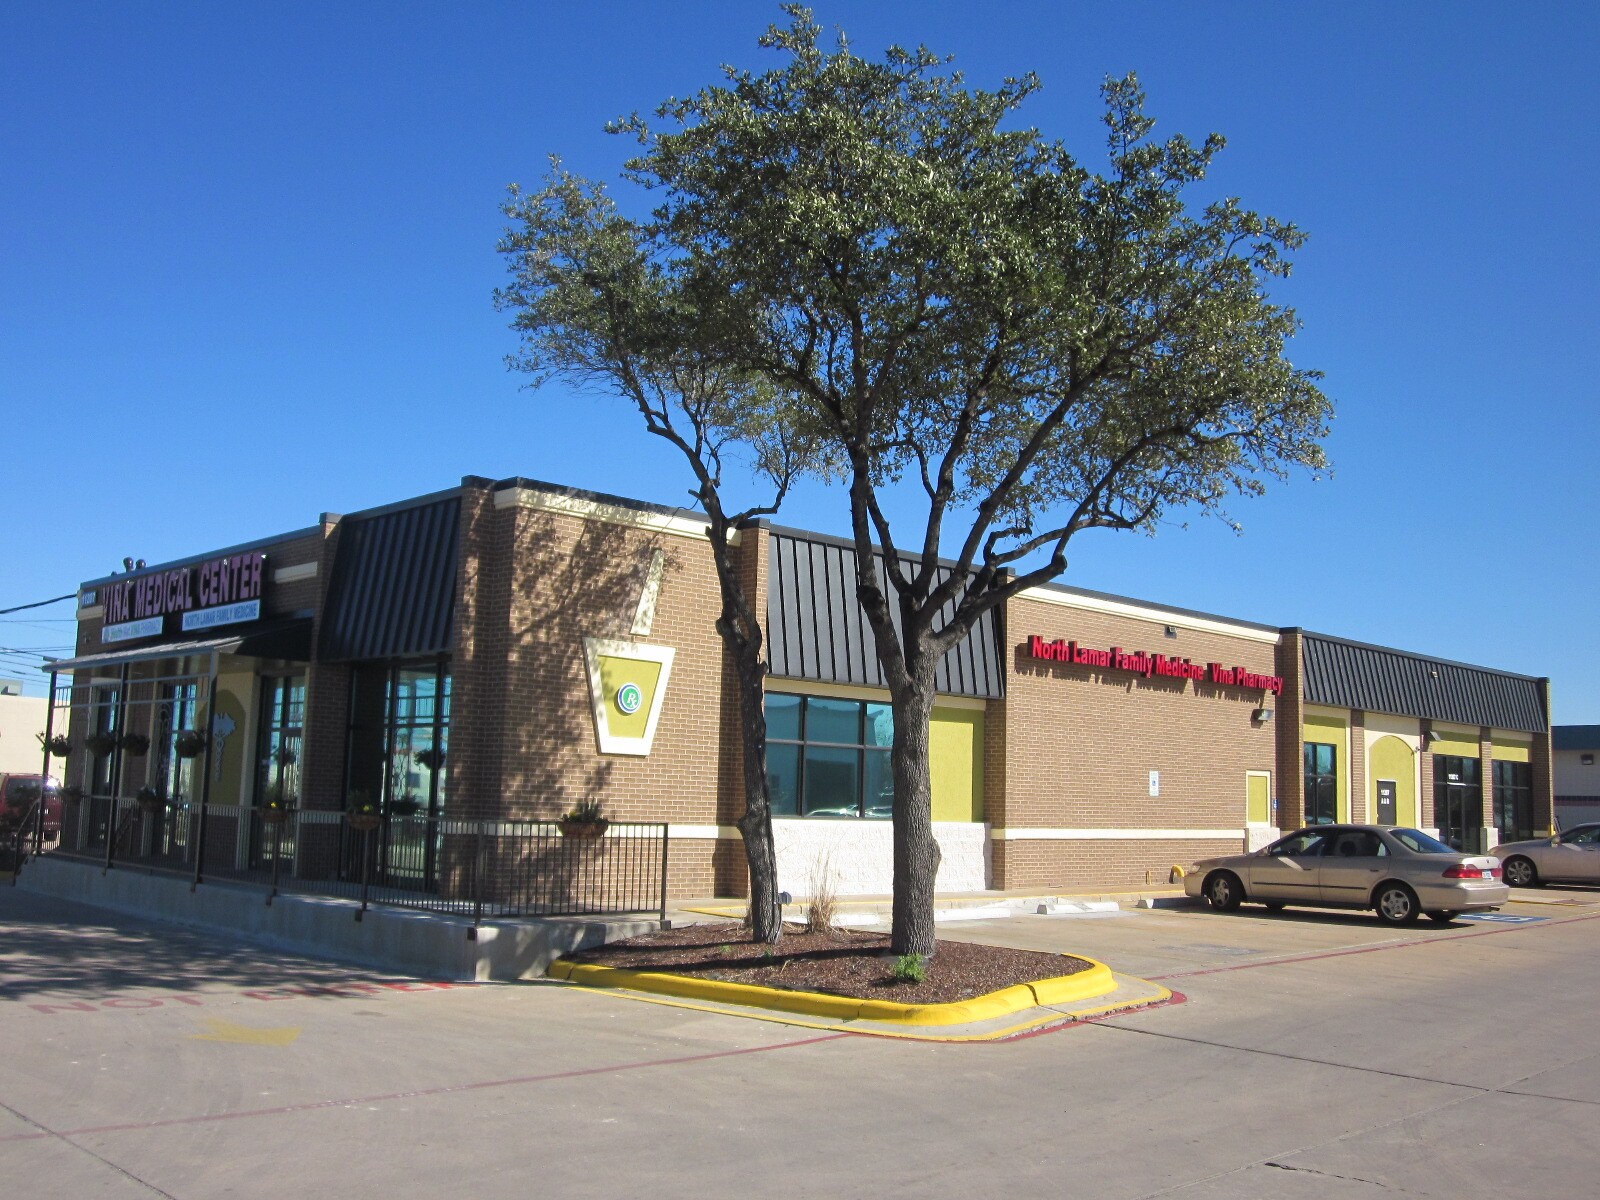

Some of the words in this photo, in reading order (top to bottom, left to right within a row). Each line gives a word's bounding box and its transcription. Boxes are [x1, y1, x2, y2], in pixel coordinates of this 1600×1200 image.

[102, 584, 130, 624] VINA
[134, 569, 192, 618] MEDICAL
[200, 552, 262, 607] CENTER
[1030, 635, 1069, 662] North
[1073, 642, 1112, 667] Lamar
[1115, 647, 1153, 678] Family
[1156, 654, 1204, 680] Medicine
[1211, 663, 1233, 684] Vina
[1236, 667, 1283, 695] Pharmacy
[27, 994, 205, 1014] NOT
